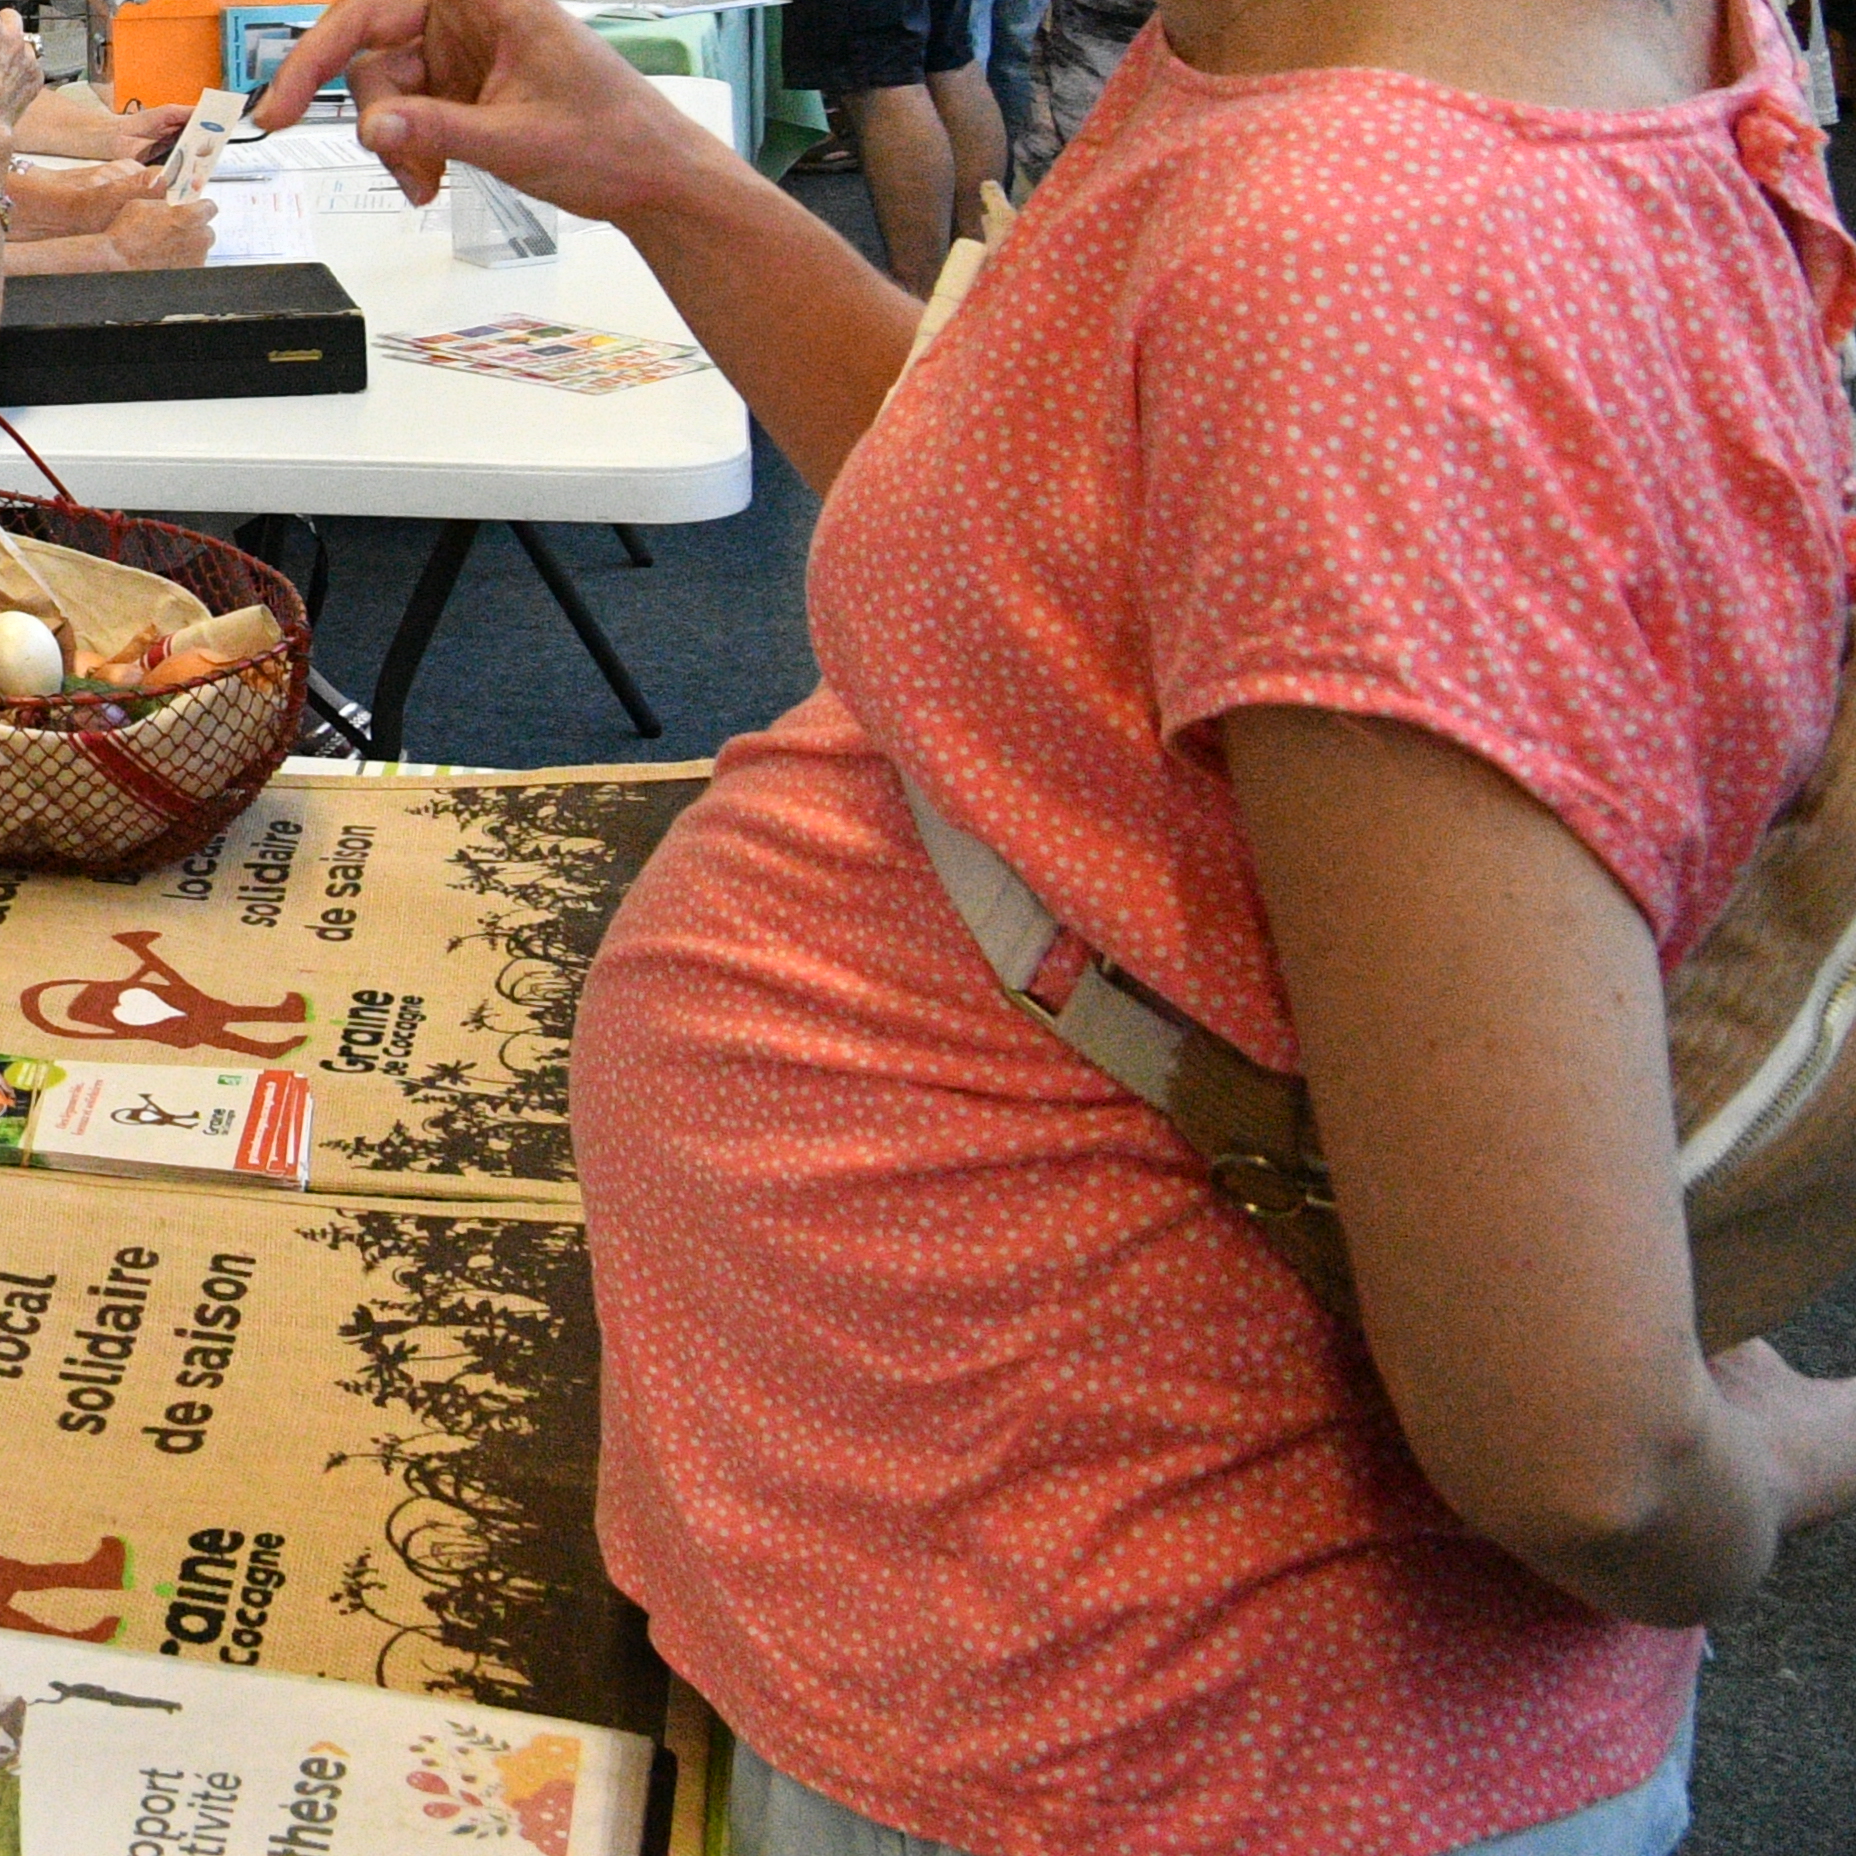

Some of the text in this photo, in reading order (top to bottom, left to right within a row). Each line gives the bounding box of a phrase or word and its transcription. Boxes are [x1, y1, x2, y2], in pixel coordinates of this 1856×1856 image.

[241, 818, 304, 928] solidaire
[304, 823, 378, 943] de saison
[319, 988, 395, 1074] Graine
[388, 995, 424, 1057] Cocagne
[59, 1244, 160, 1436] solidaire
[141, 1251, 257, 1456] de saison
[220, 1531, 285, 1668] Cocagne
